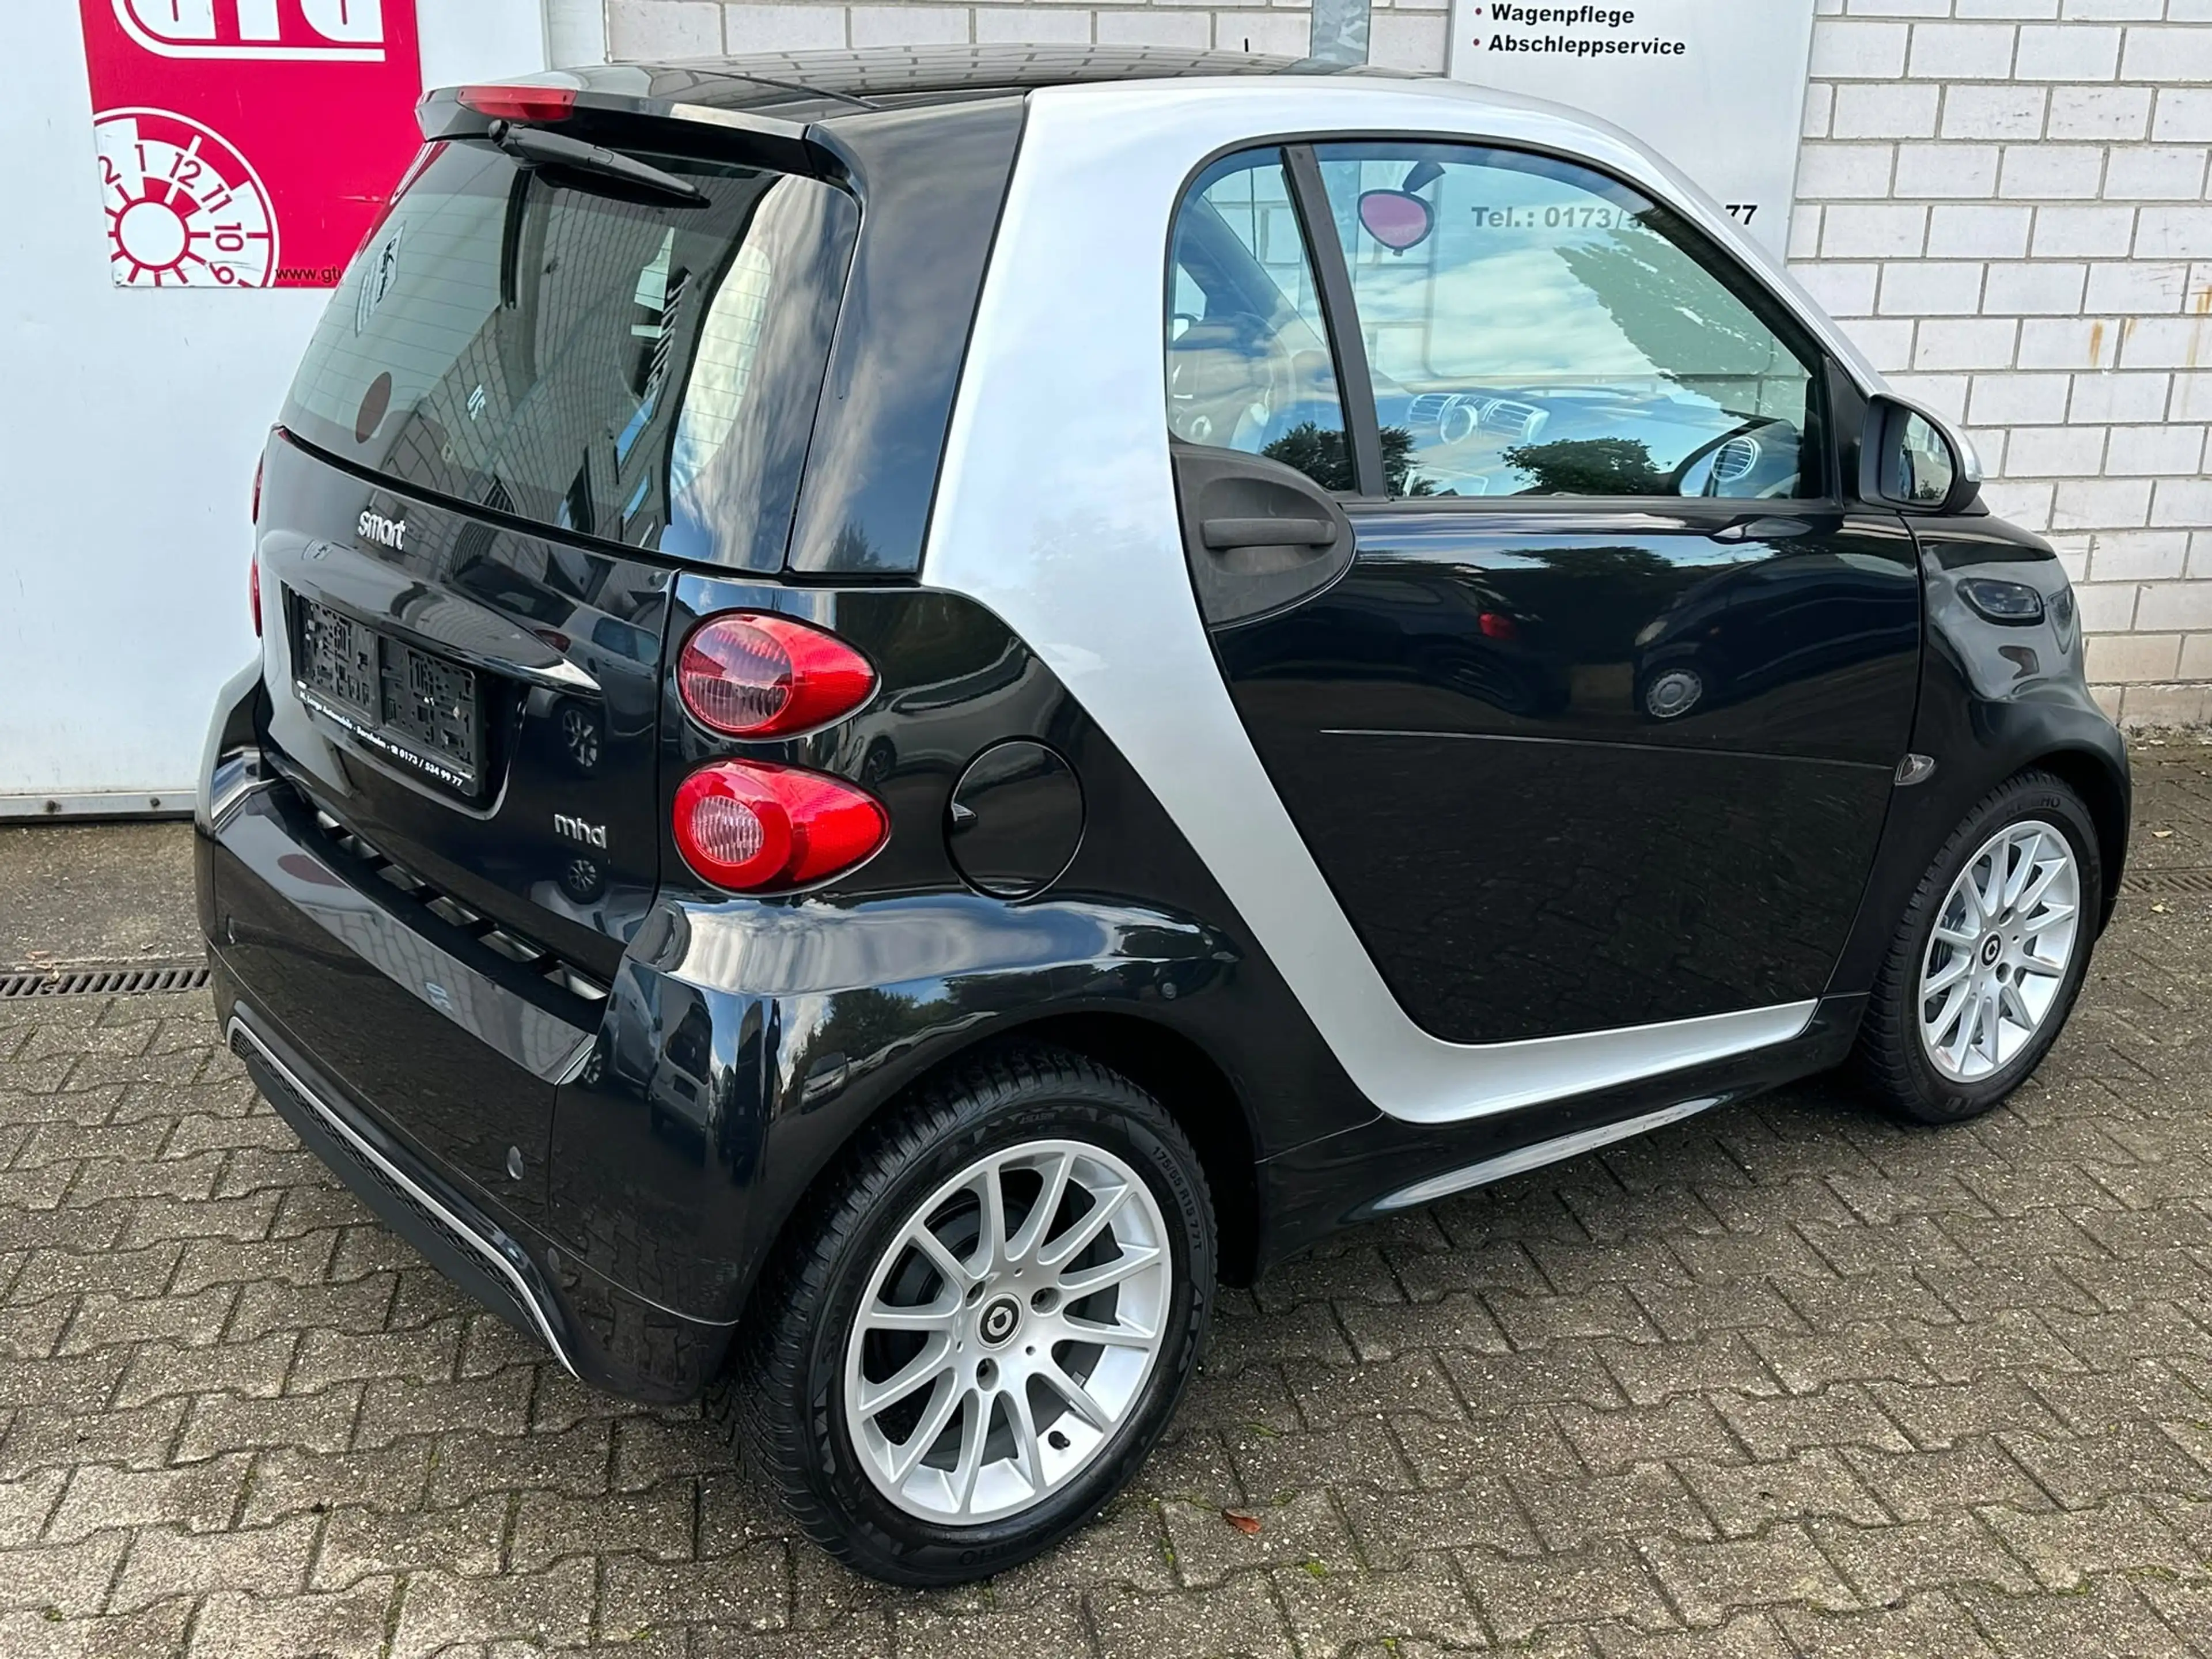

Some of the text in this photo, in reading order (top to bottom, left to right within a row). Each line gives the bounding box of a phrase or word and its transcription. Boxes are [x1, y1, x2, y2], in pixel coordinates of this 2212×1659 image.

[1491, 3, 1635, 28] Wagenpflege
[1488, 35, 1685, 58] Abschleppservice
[134, 143, 146, 172] 1
[169, 151, 202, 190] 12
[200, 183, 233, 214] 11
[1725, 204, 1758, 225] 77
[214, 222, 244, 252] 10
[357, 511, 406, 550] smart
[399, 749, 418, 765] 0173
[425, 762, 440, 775] 534
[452, 775, 463, 786] 77
[554, 813, 607, 849] mhd
